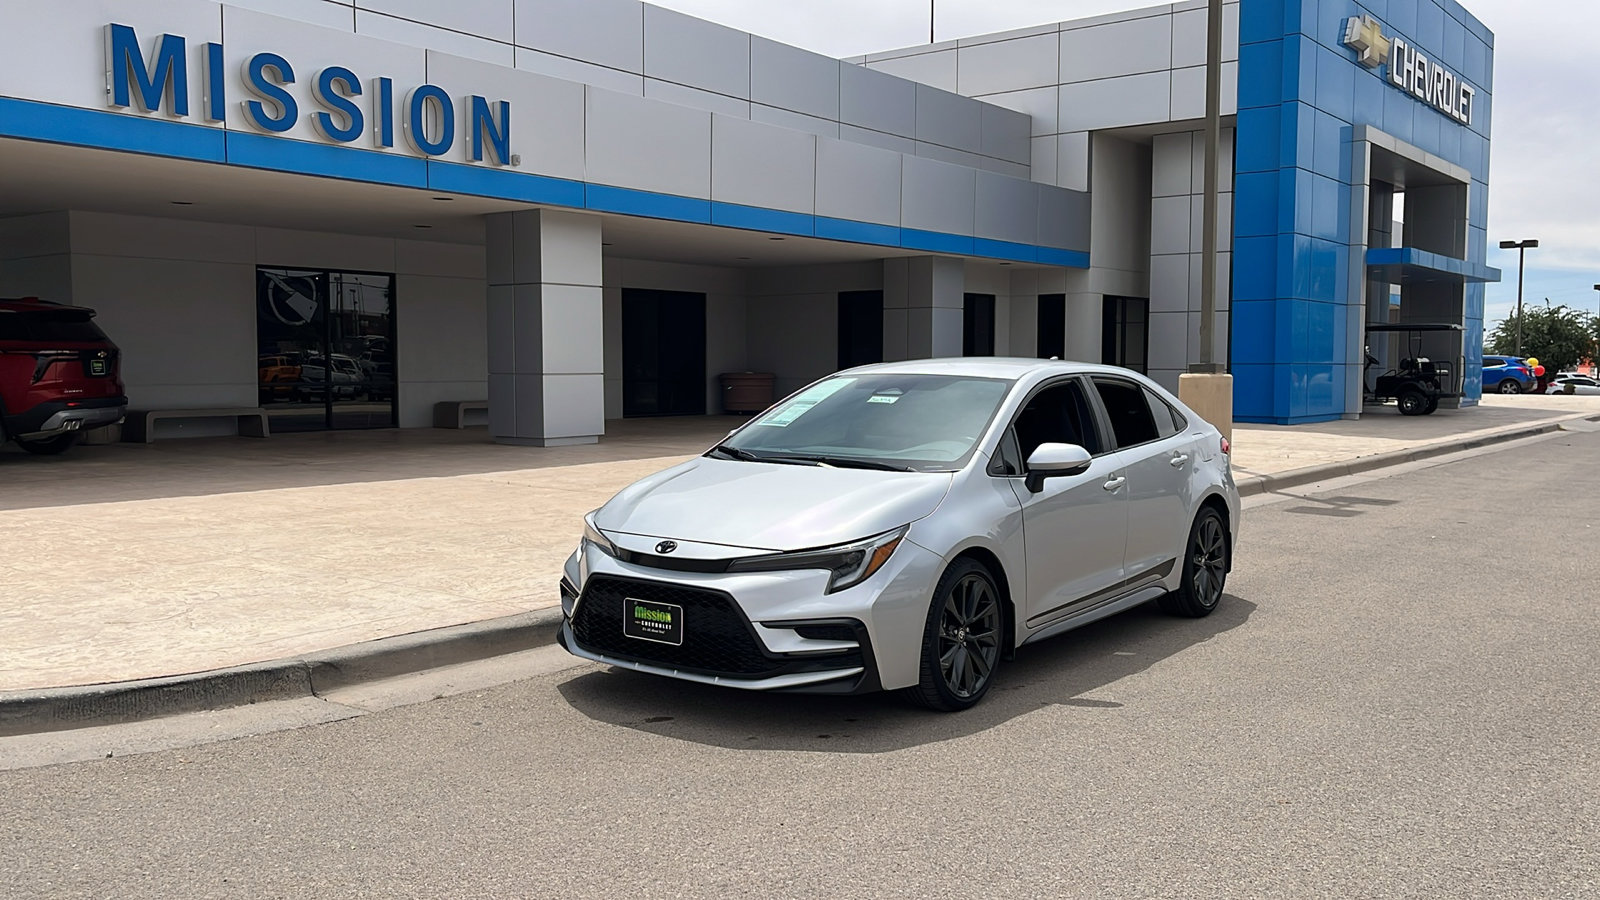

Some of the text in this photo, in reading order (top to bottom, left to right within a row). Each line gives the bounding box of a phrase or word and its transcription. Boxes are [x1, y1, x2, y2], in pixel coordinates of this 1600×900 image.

[105, 23, 510, 166] MISSION
[1391, 37, 1475, 124] CHEVROLET
[635, 605, 671, 623] Mission
